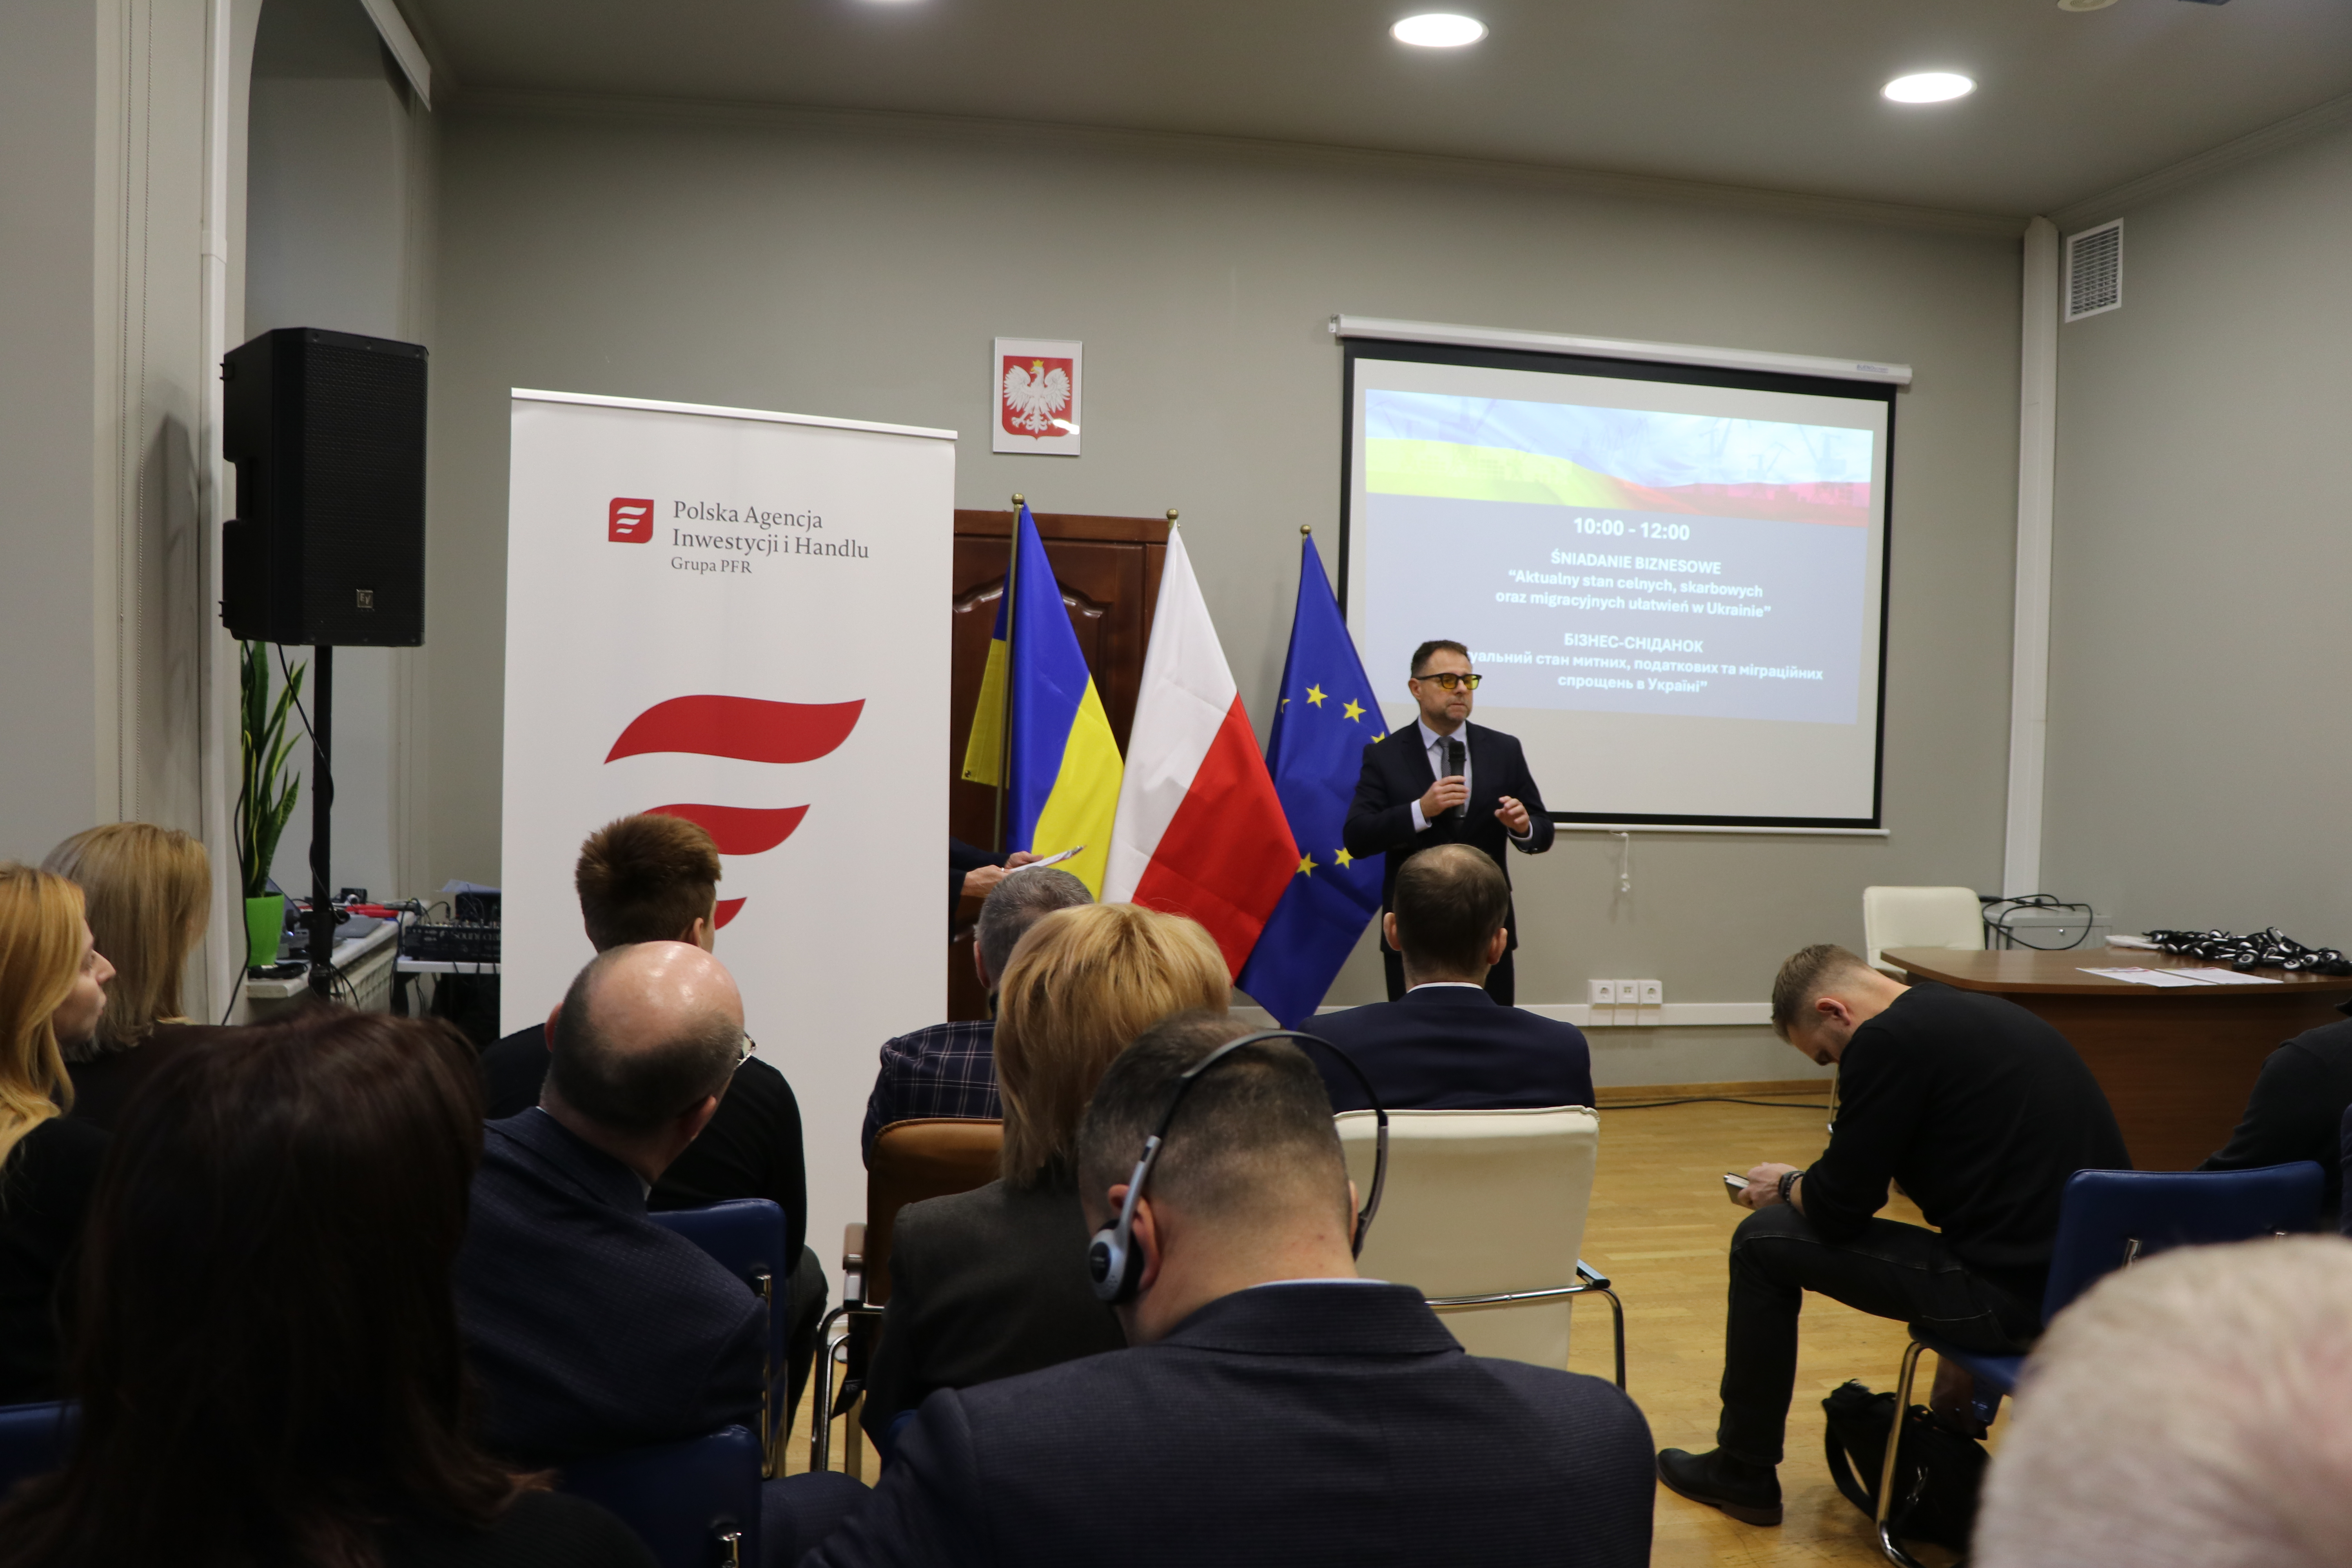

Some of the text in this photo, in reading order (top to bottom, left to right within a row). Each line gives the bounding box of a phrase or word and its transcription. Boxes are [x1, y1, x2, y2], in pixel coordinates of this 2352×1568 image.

[673, 500, 823, 532] Polska Agencja
[1573, 517, 1624, 536] 10:00
[1641, 522, 1690, 541] 12:00
[672, 528, 869, 558] Inwestycji i Handlu
[671, 557, 752, 574] Grupa PFR
[1551, 548, 1721, 575] ŚNIADANIE BIZNESOWE
[1508, 570, 1763, 599] “Aktualny stan celnych, skarbowych
[1495, 592, 1771, 617] oraz migracyjnych ułatwień w Ukrainie”
[1564, 633, 1704, 652] БІЗНЕС-СНІДАНОК
[1466, 651, 1823, 680] уальний стан митних, податкових та міграційних
[1558, 675, 1708, 693] спрощень в Україні”
